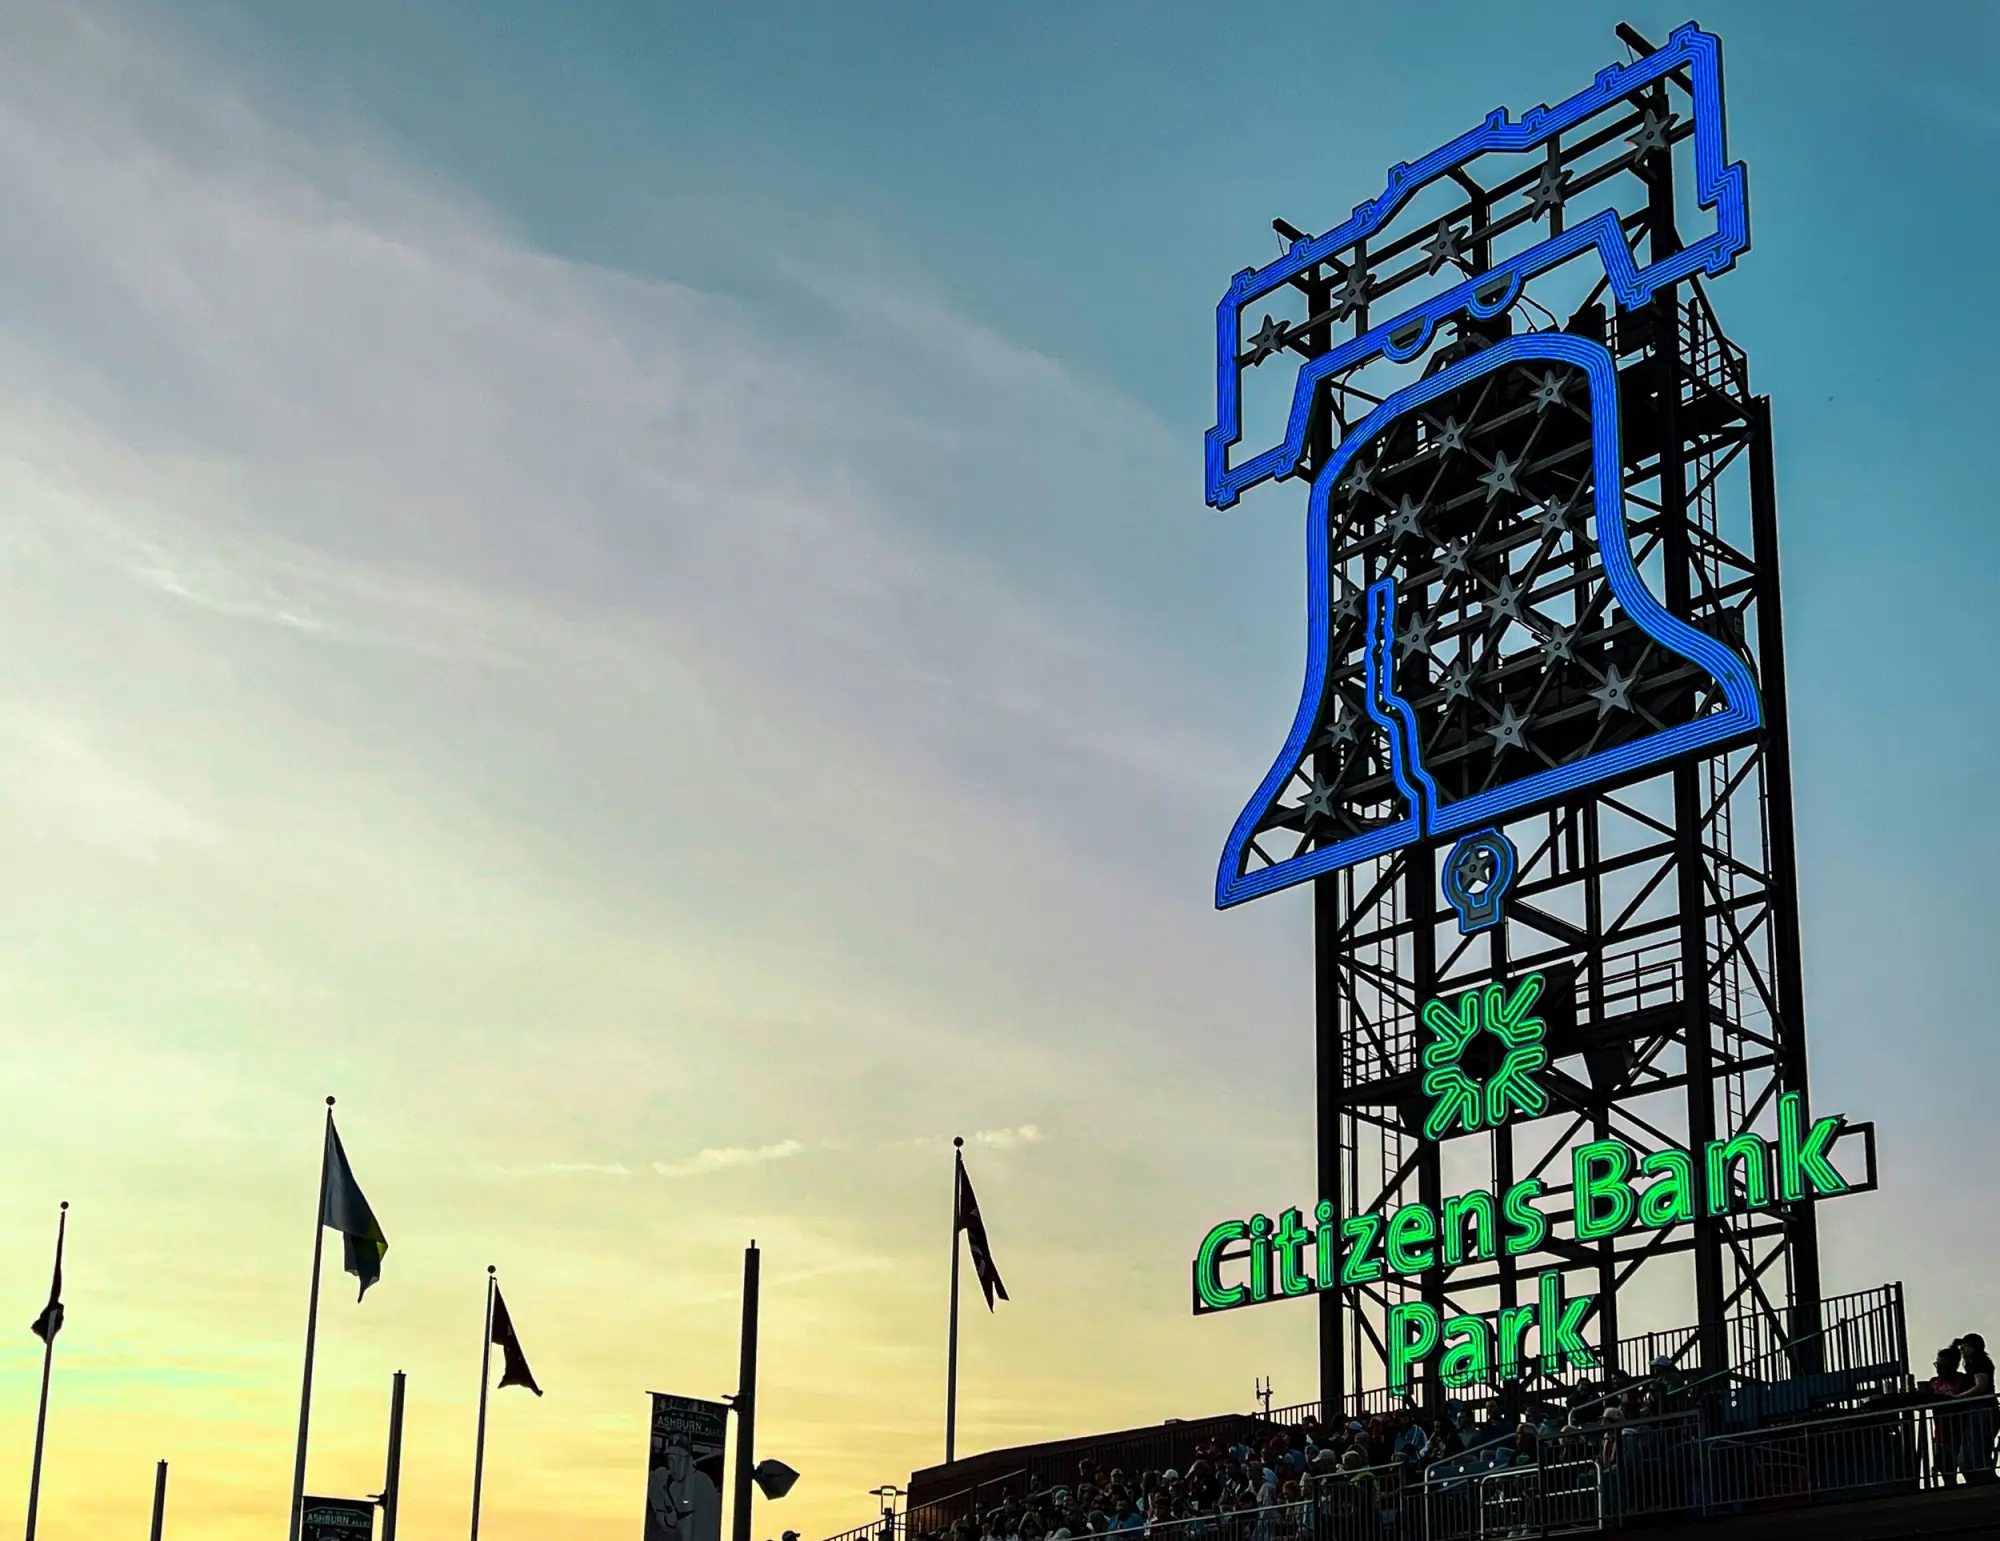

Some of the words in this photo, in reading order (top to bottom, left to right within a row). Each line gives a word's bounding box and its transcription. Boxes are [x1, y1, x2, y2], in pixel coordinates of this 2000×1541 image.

[1196, 1178, 1547, 1309] Citizens
[1571, 1091, 1848, 1242] Bank
[1387, 1269, 1600, 1396] Park
[656, 1415, 702, 1432] ASHBURN
[307, 1513, 350, 1525] ASHBURN
